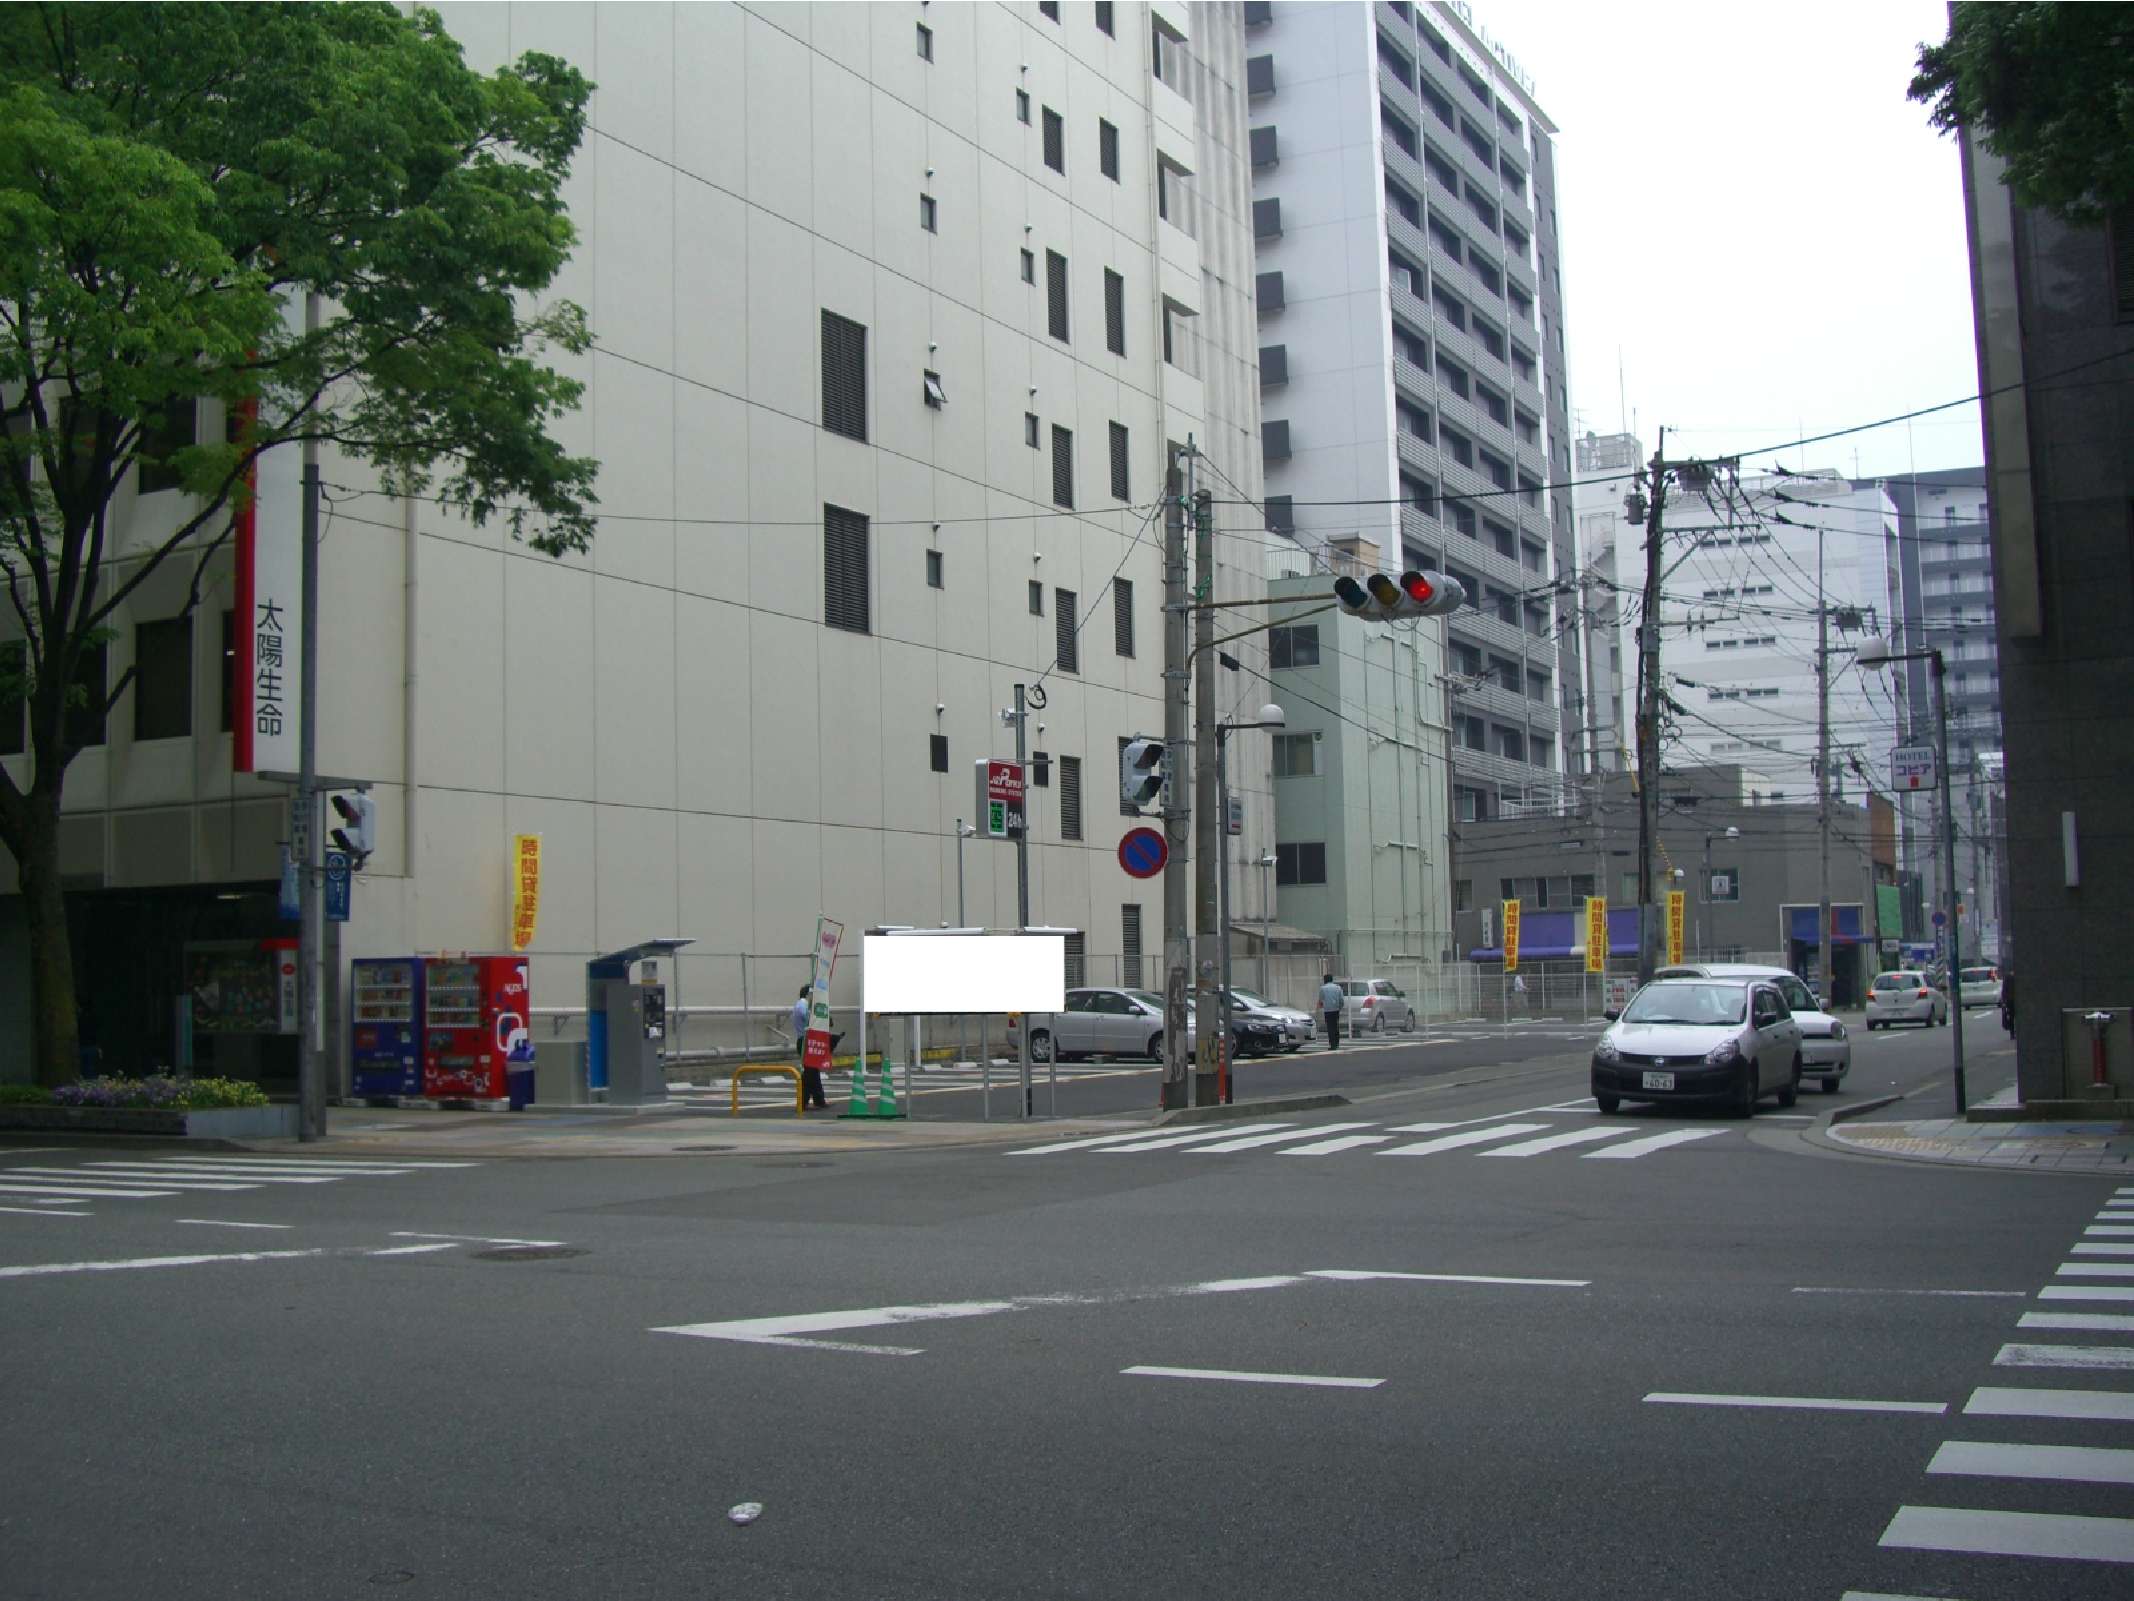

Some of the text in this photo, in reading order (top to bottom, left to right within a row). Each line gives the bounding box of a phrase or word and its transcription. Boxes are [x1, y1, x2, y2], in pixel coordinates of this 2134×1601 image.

[256, 597, 284, 737] 太陽生命
[1895, 751, 1929, 761] HOTEL
